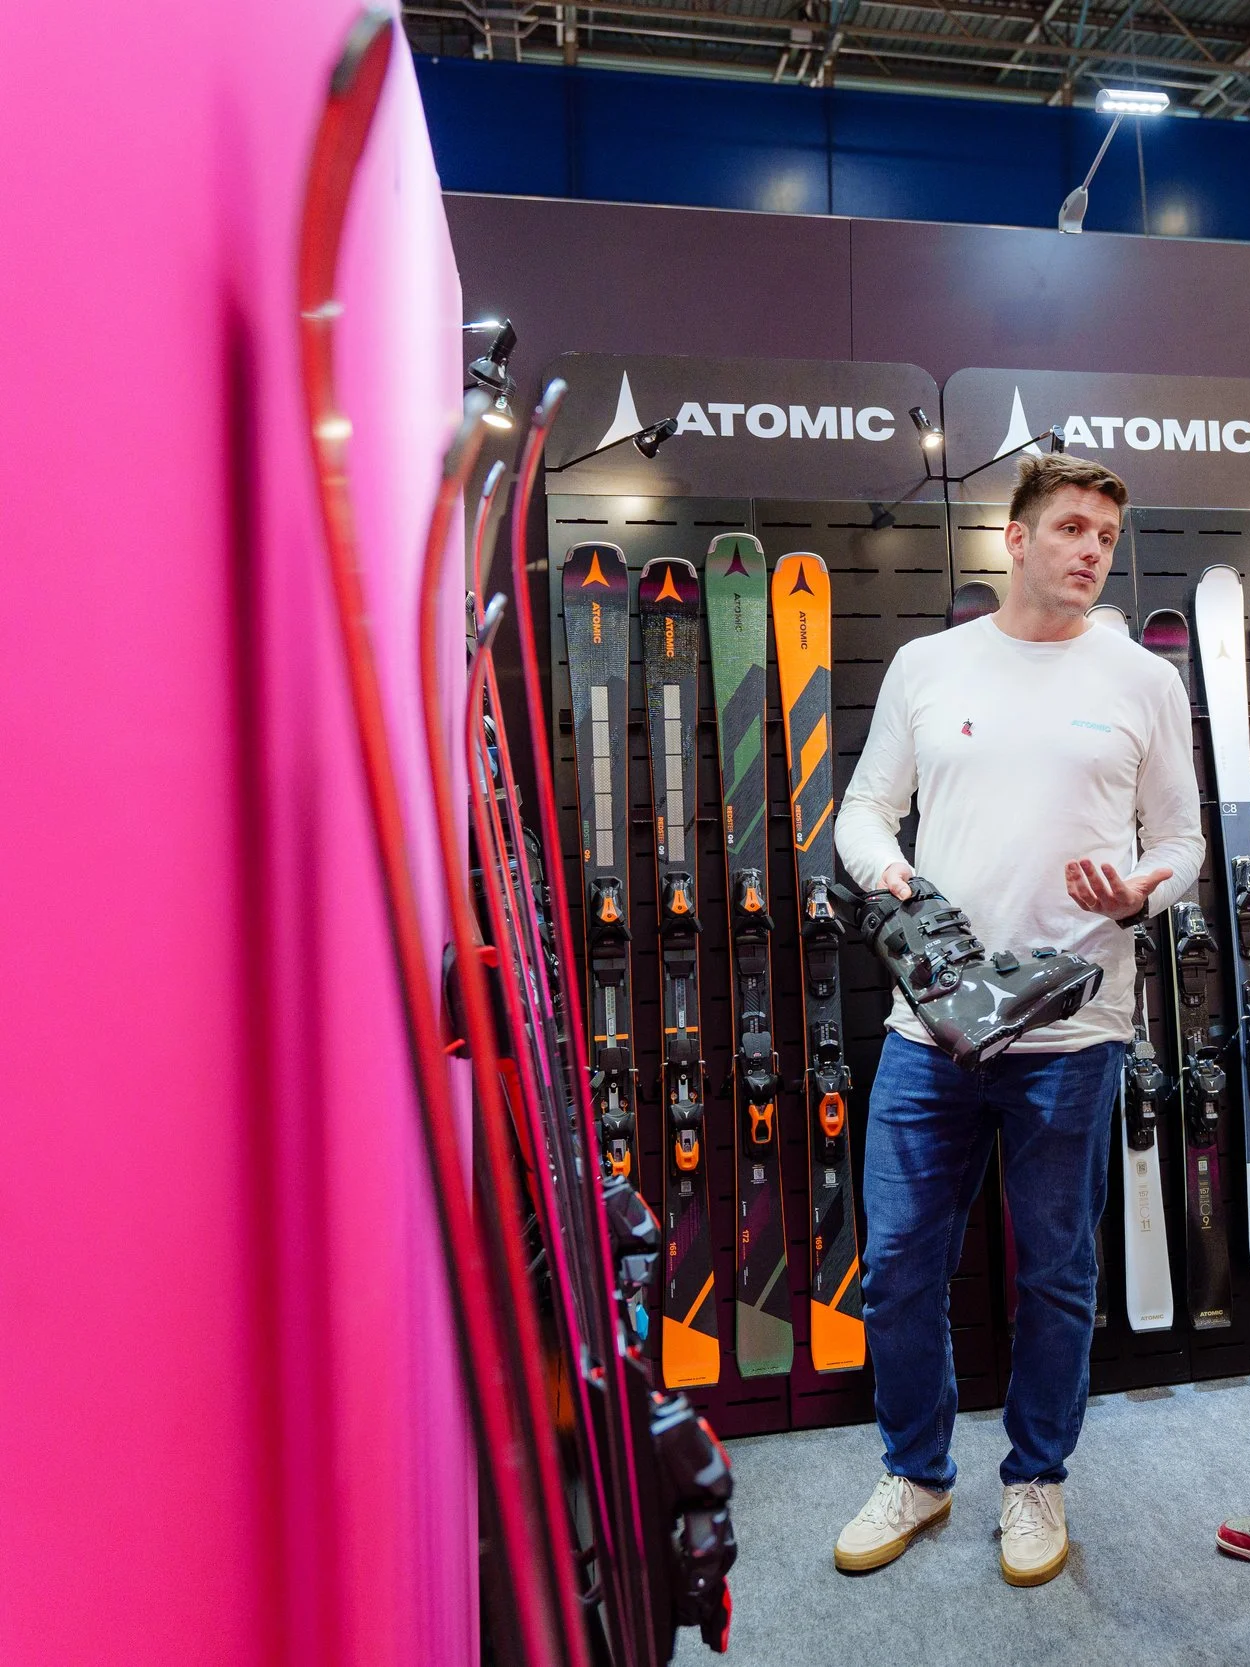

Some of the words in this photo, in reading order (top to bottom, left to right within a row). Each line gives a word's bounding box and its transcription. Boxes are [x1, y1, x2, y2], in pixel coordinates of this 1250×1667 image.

[674, 401, 896, 441] ATOMIC
[591, 601, 602, 645] ATOMIC
[734, 592, 743, 633] ATOMIC
[664, 616, 675, 658] ATOMIC
[798, 610, 808, 650] ATOMIC
[726, 805, 734, 833] REDSTER
[1222, 803, 1238, 815] C8
[657, 816, 665, 844] REDSTER
[658, 845, 665, 855] Q9
[742, 1229, 750, 1244] 172
[815, 1235, 823, 1250] 169
[669, 1241, 677, 1257] 168
[1140, 1313, 1165, 1322] ATOMIC
[1200, 1308, 1224, 1318] ATOMIC
